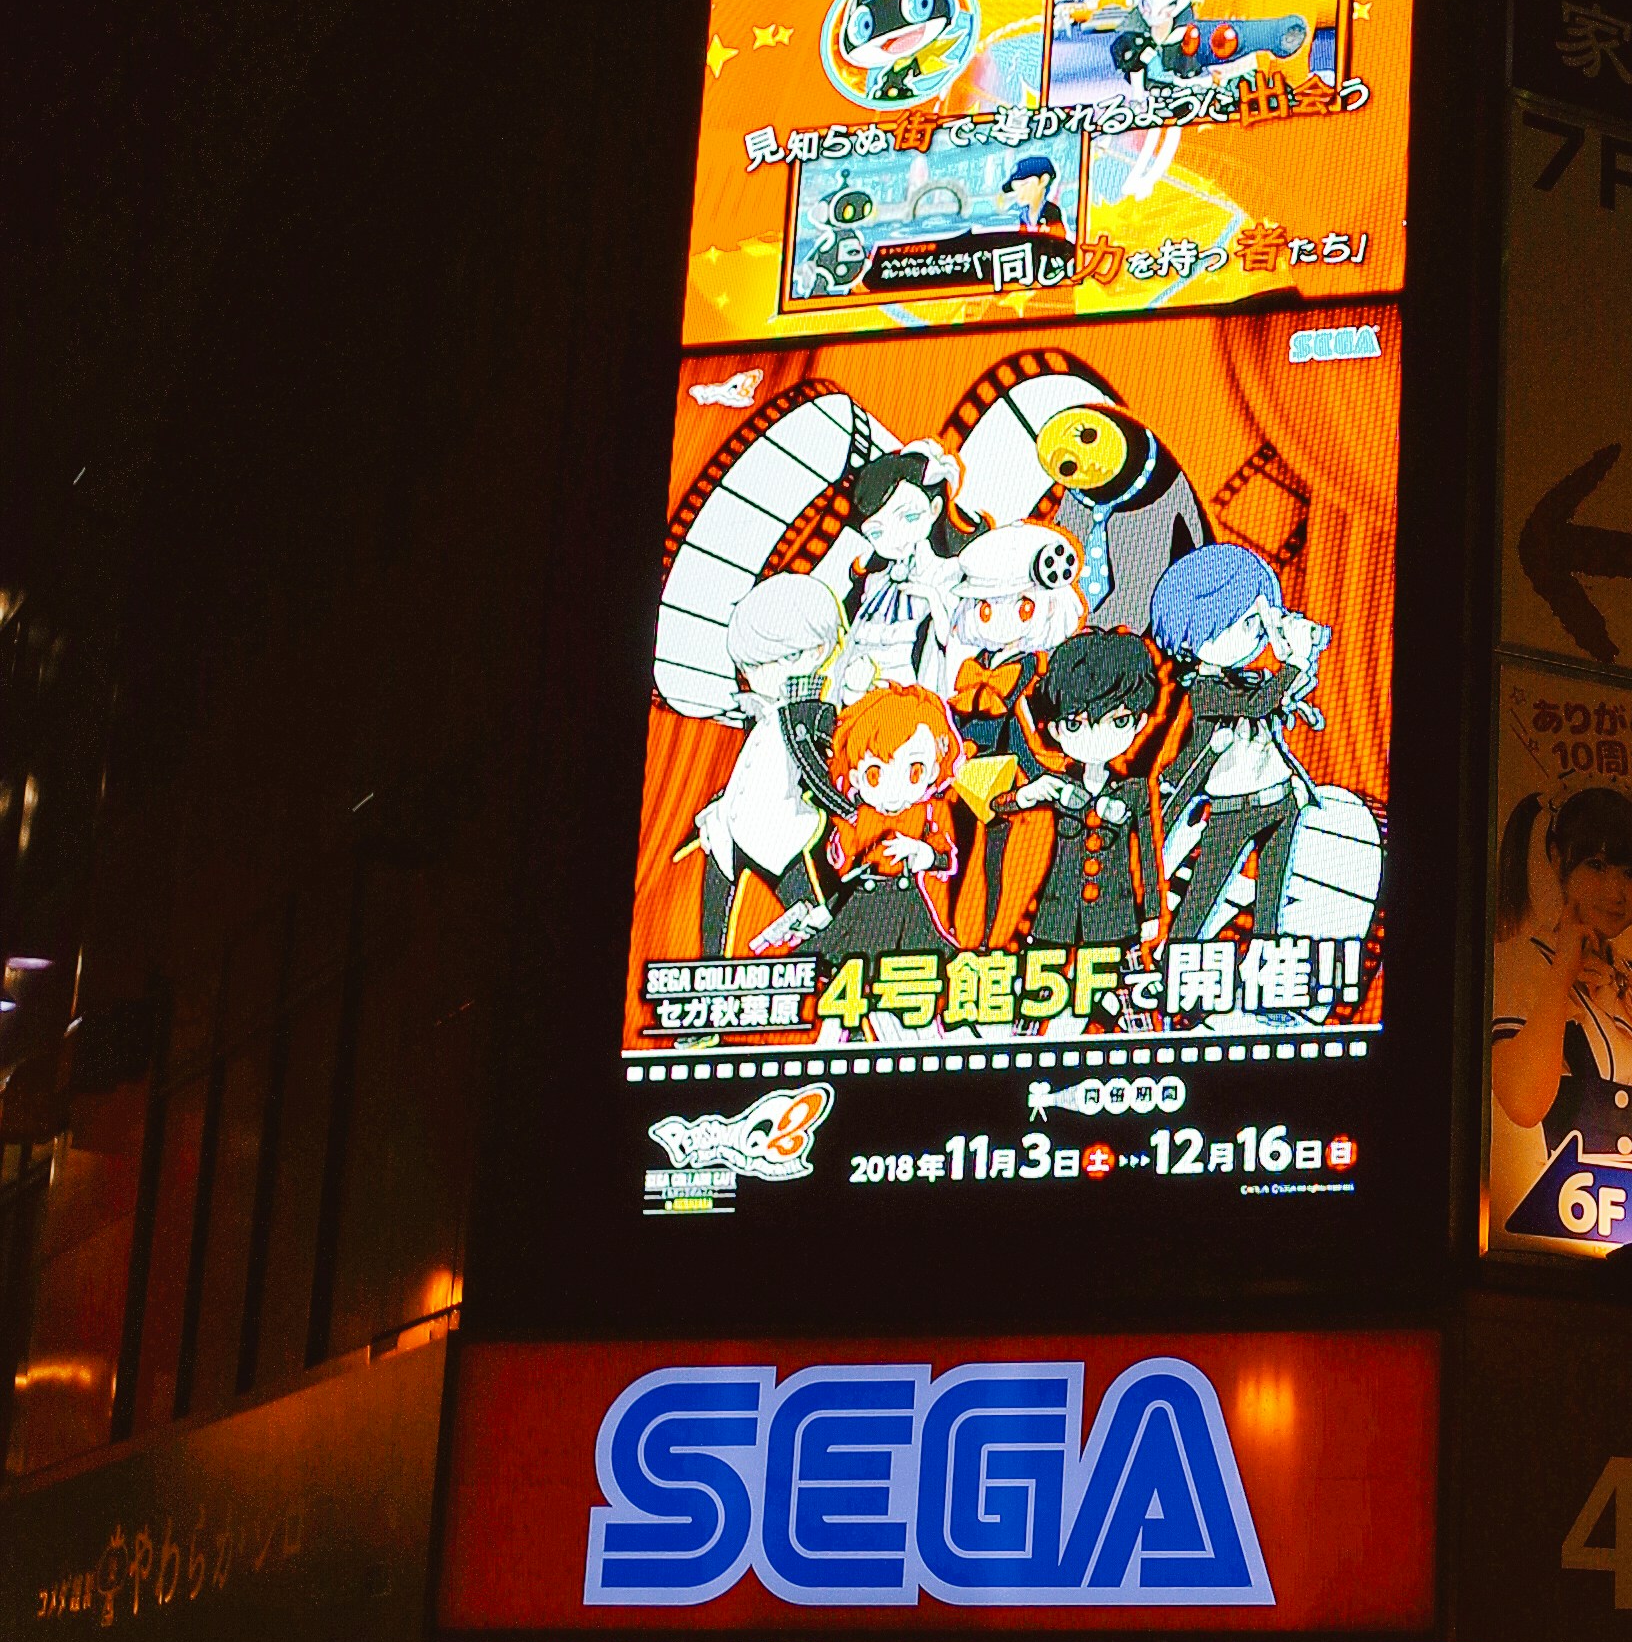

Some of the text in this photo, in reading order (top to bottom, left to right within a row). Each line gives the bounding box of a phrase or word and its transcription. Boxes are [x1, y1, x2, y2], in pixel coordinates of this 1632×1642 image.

[647, 962, 815, 993] SEGA COLLABO CAFE
[657, 994, 800, 1028] セガ秋葉原
[1558, 1175, 1626, 1236] 6F
[583, 1355, 1276, 1606] SEGA
